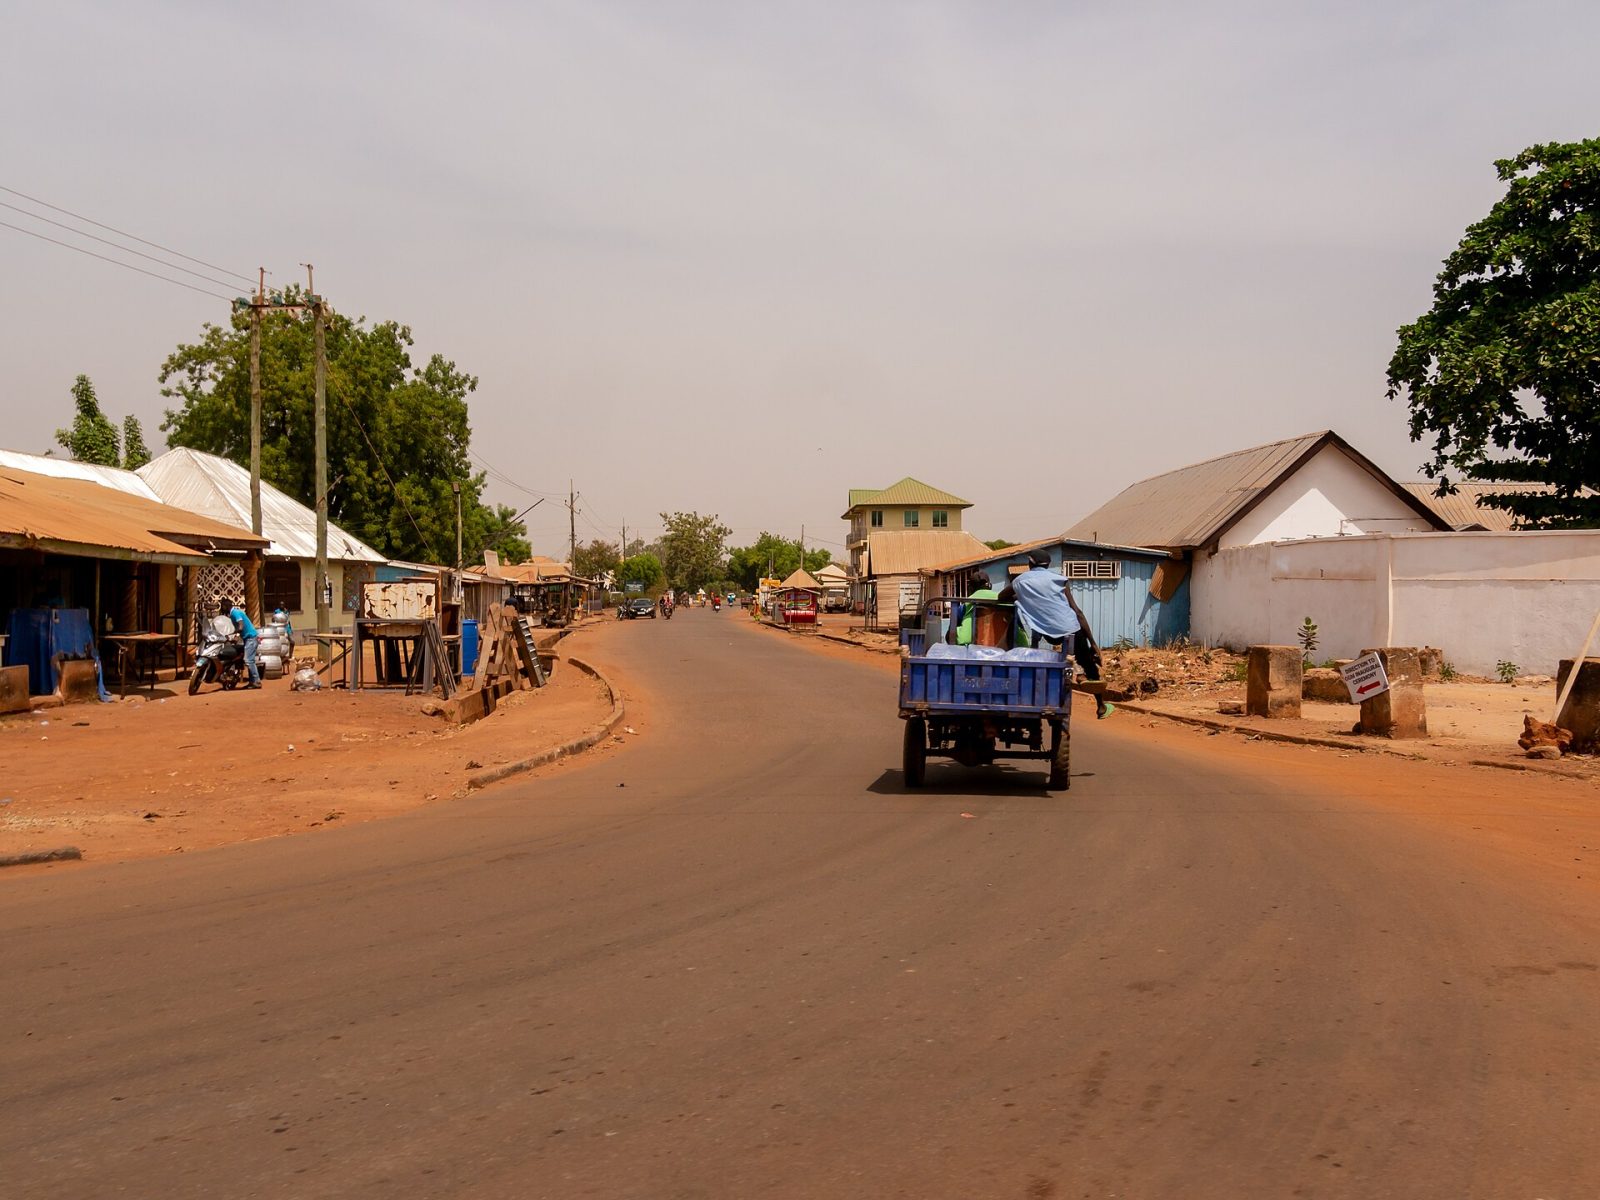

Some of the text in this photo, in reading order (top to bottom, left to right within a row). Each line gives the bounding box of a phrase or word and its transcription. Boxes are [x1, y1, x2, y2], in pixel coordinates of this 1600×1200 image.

[1345, 661, 1368, 674] DIRECTION
[1355, 663, 1381, 677] INAUGURAL
[1352, 671, 1377, 685] CEREMONY
